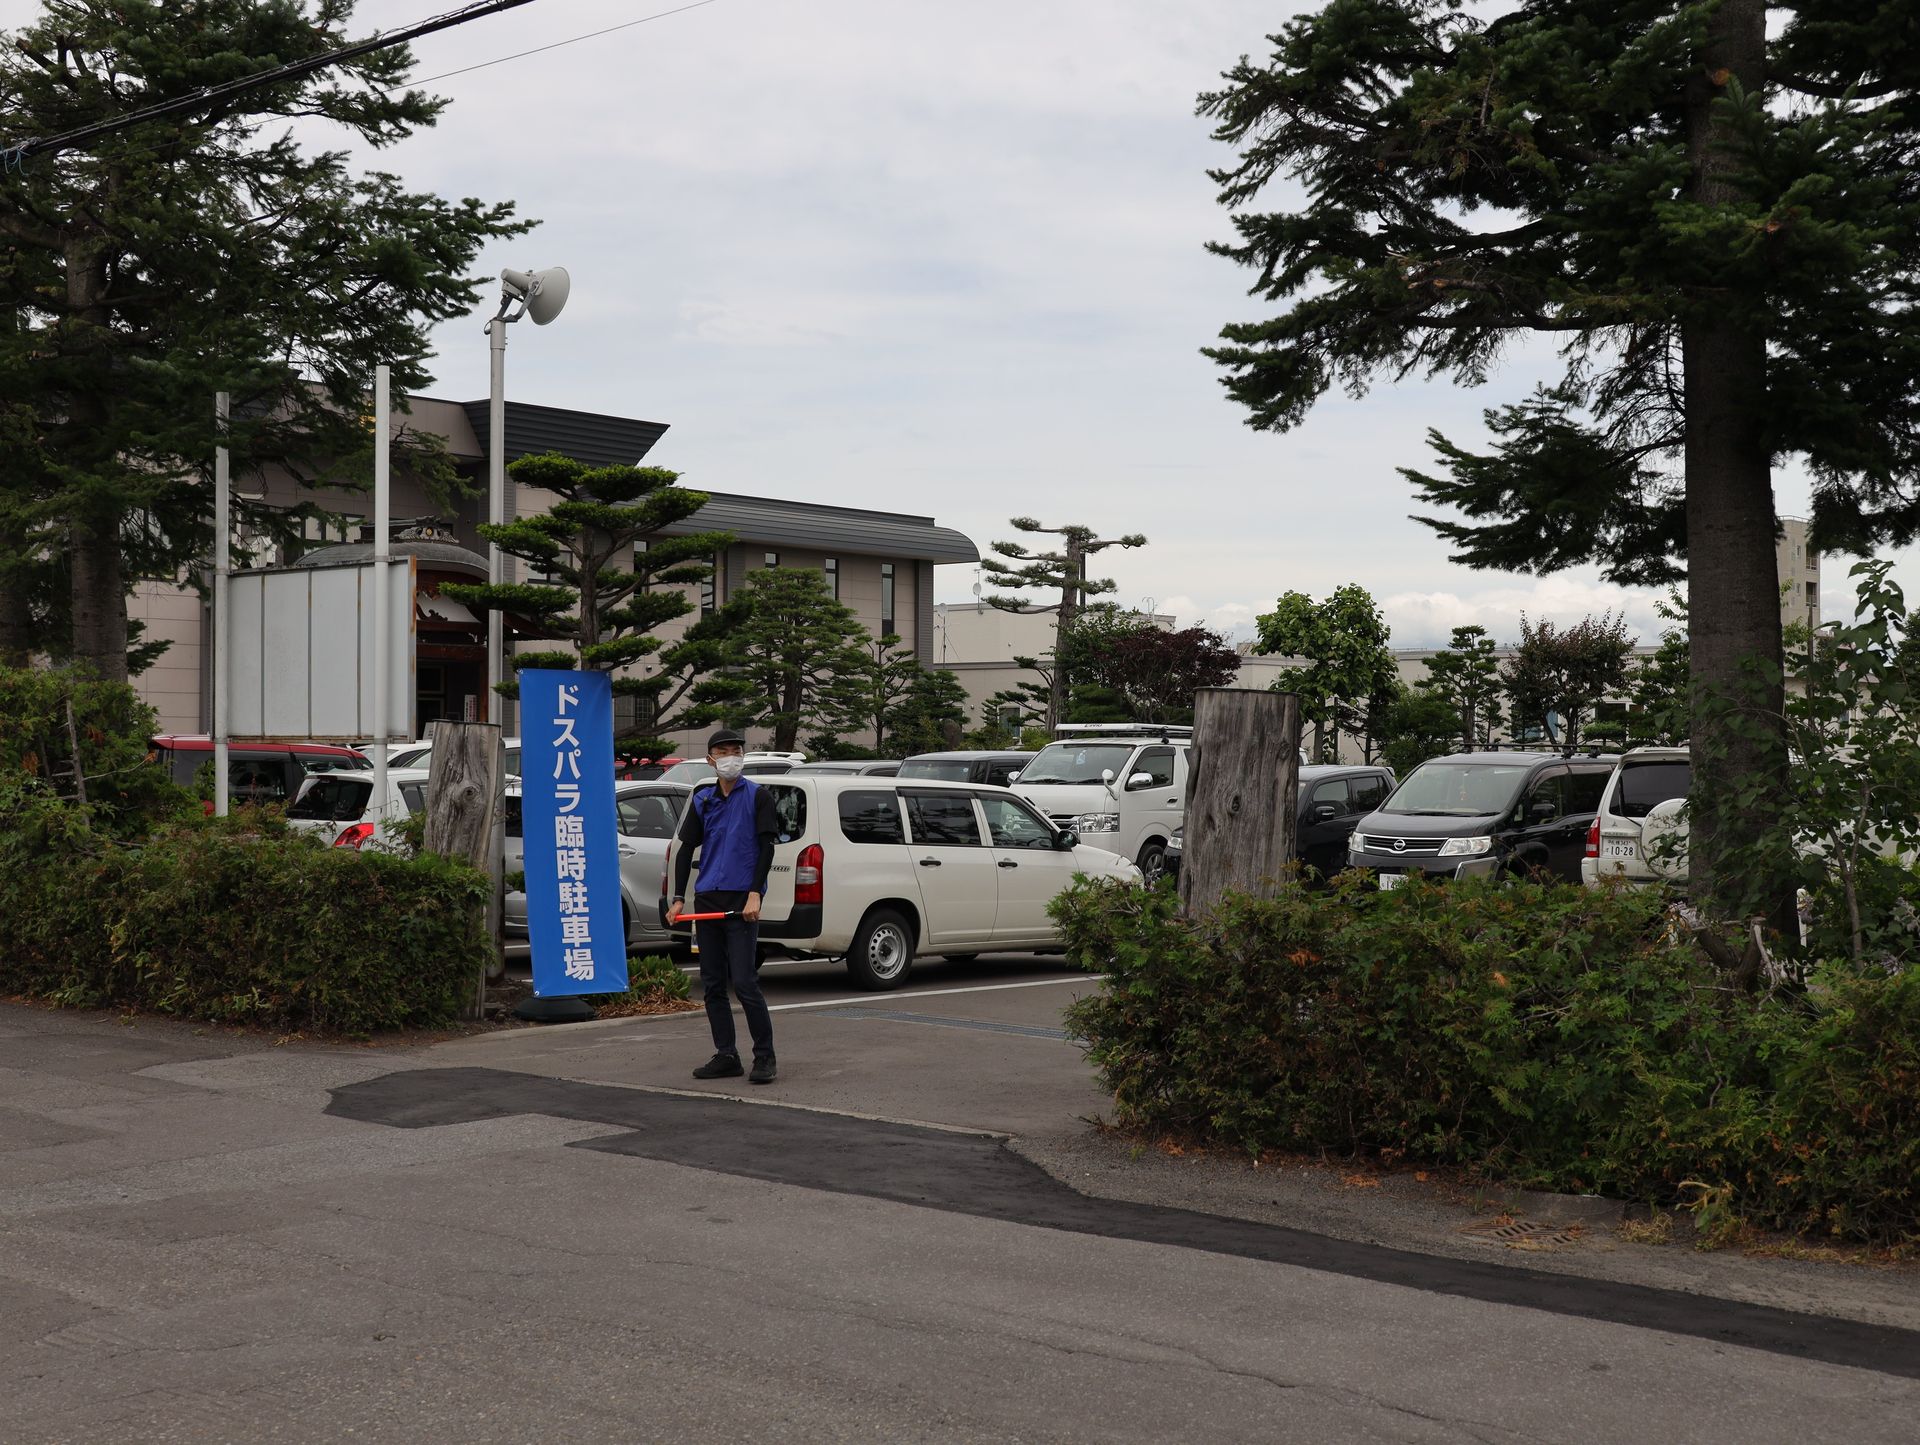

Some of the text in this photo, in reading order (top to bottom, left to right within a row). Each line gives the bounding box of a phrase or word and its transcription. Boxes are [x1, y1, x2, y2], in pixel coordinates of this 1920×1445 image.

[552, 684, 595, 982] ドスパラ臨時駐車場
[1611, 846, 1634, 856] 10-28
